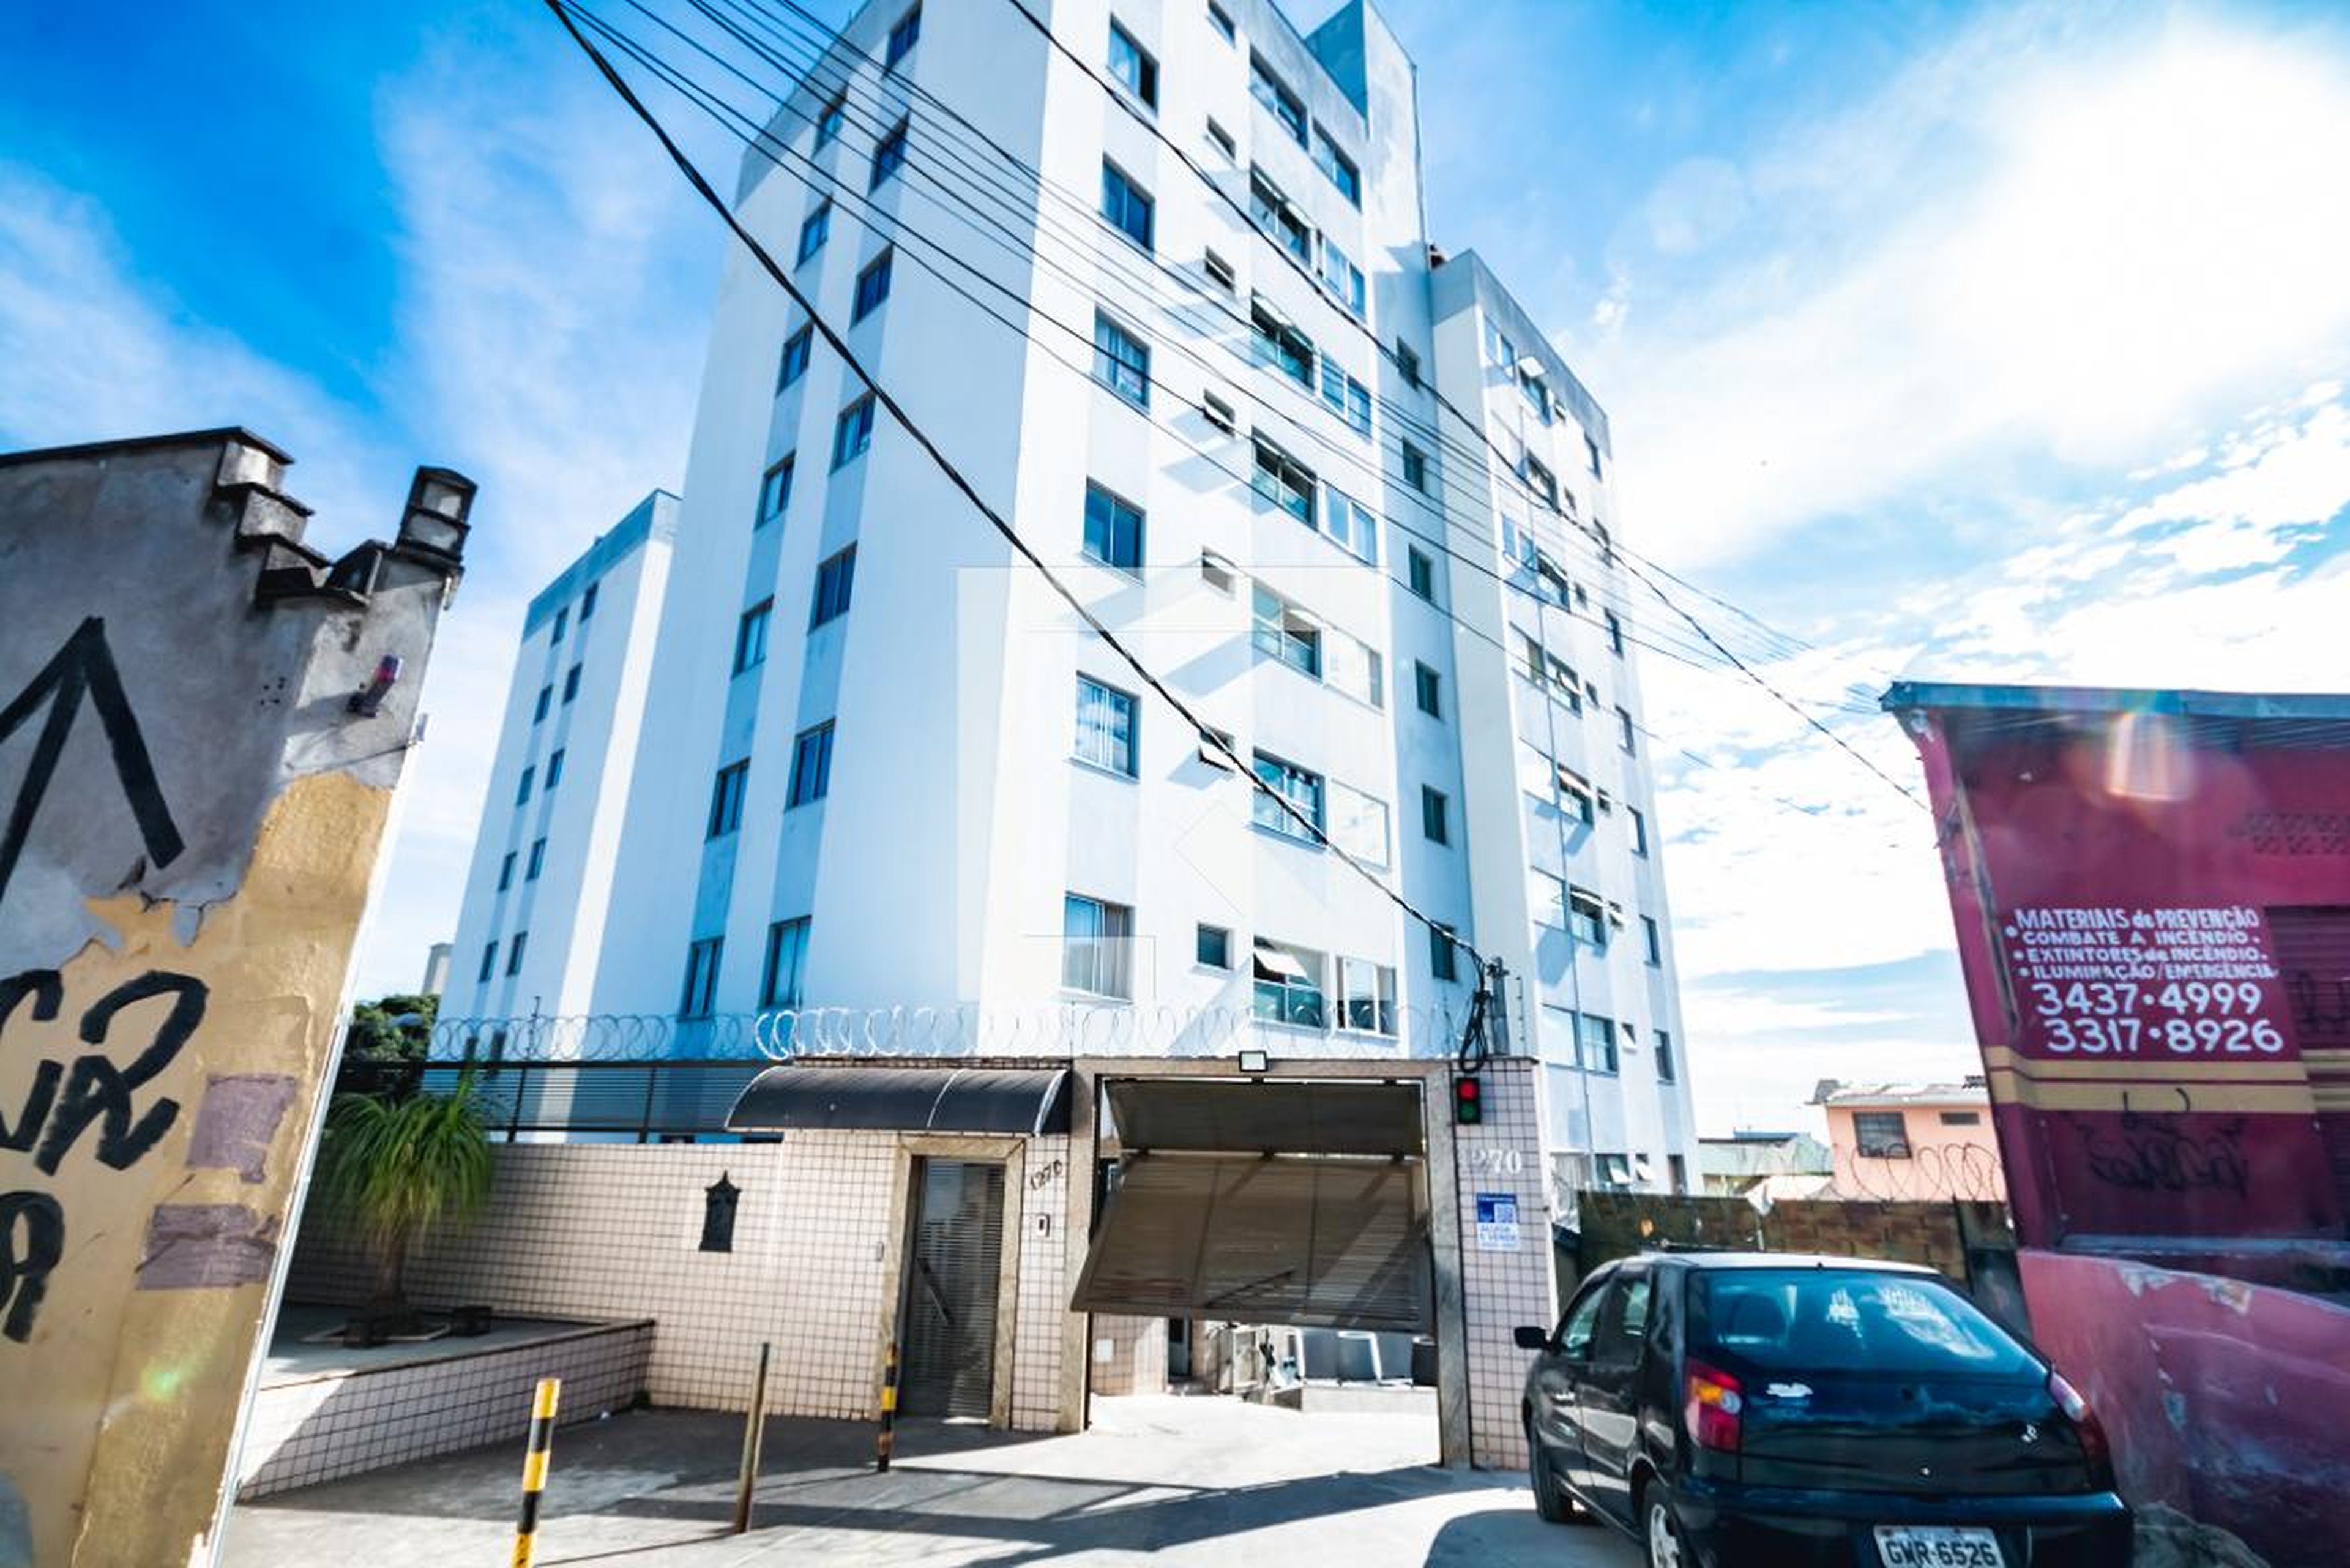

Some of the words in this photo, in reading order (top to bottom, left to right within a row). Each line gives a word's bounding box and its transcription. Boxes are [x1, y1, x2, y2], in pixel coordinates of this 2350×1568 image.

[2014, 908, 2130, 929] MATERIAIS
[2132, 910, 2154, 928] de
[2154, 906, 2260, 931] PREVENÇÃO
[2023, 931, 2121, 945] COMBATE
[2130, 930, 2147, 945] A
[2027, 947, 2142, 963] EXTINTORES
